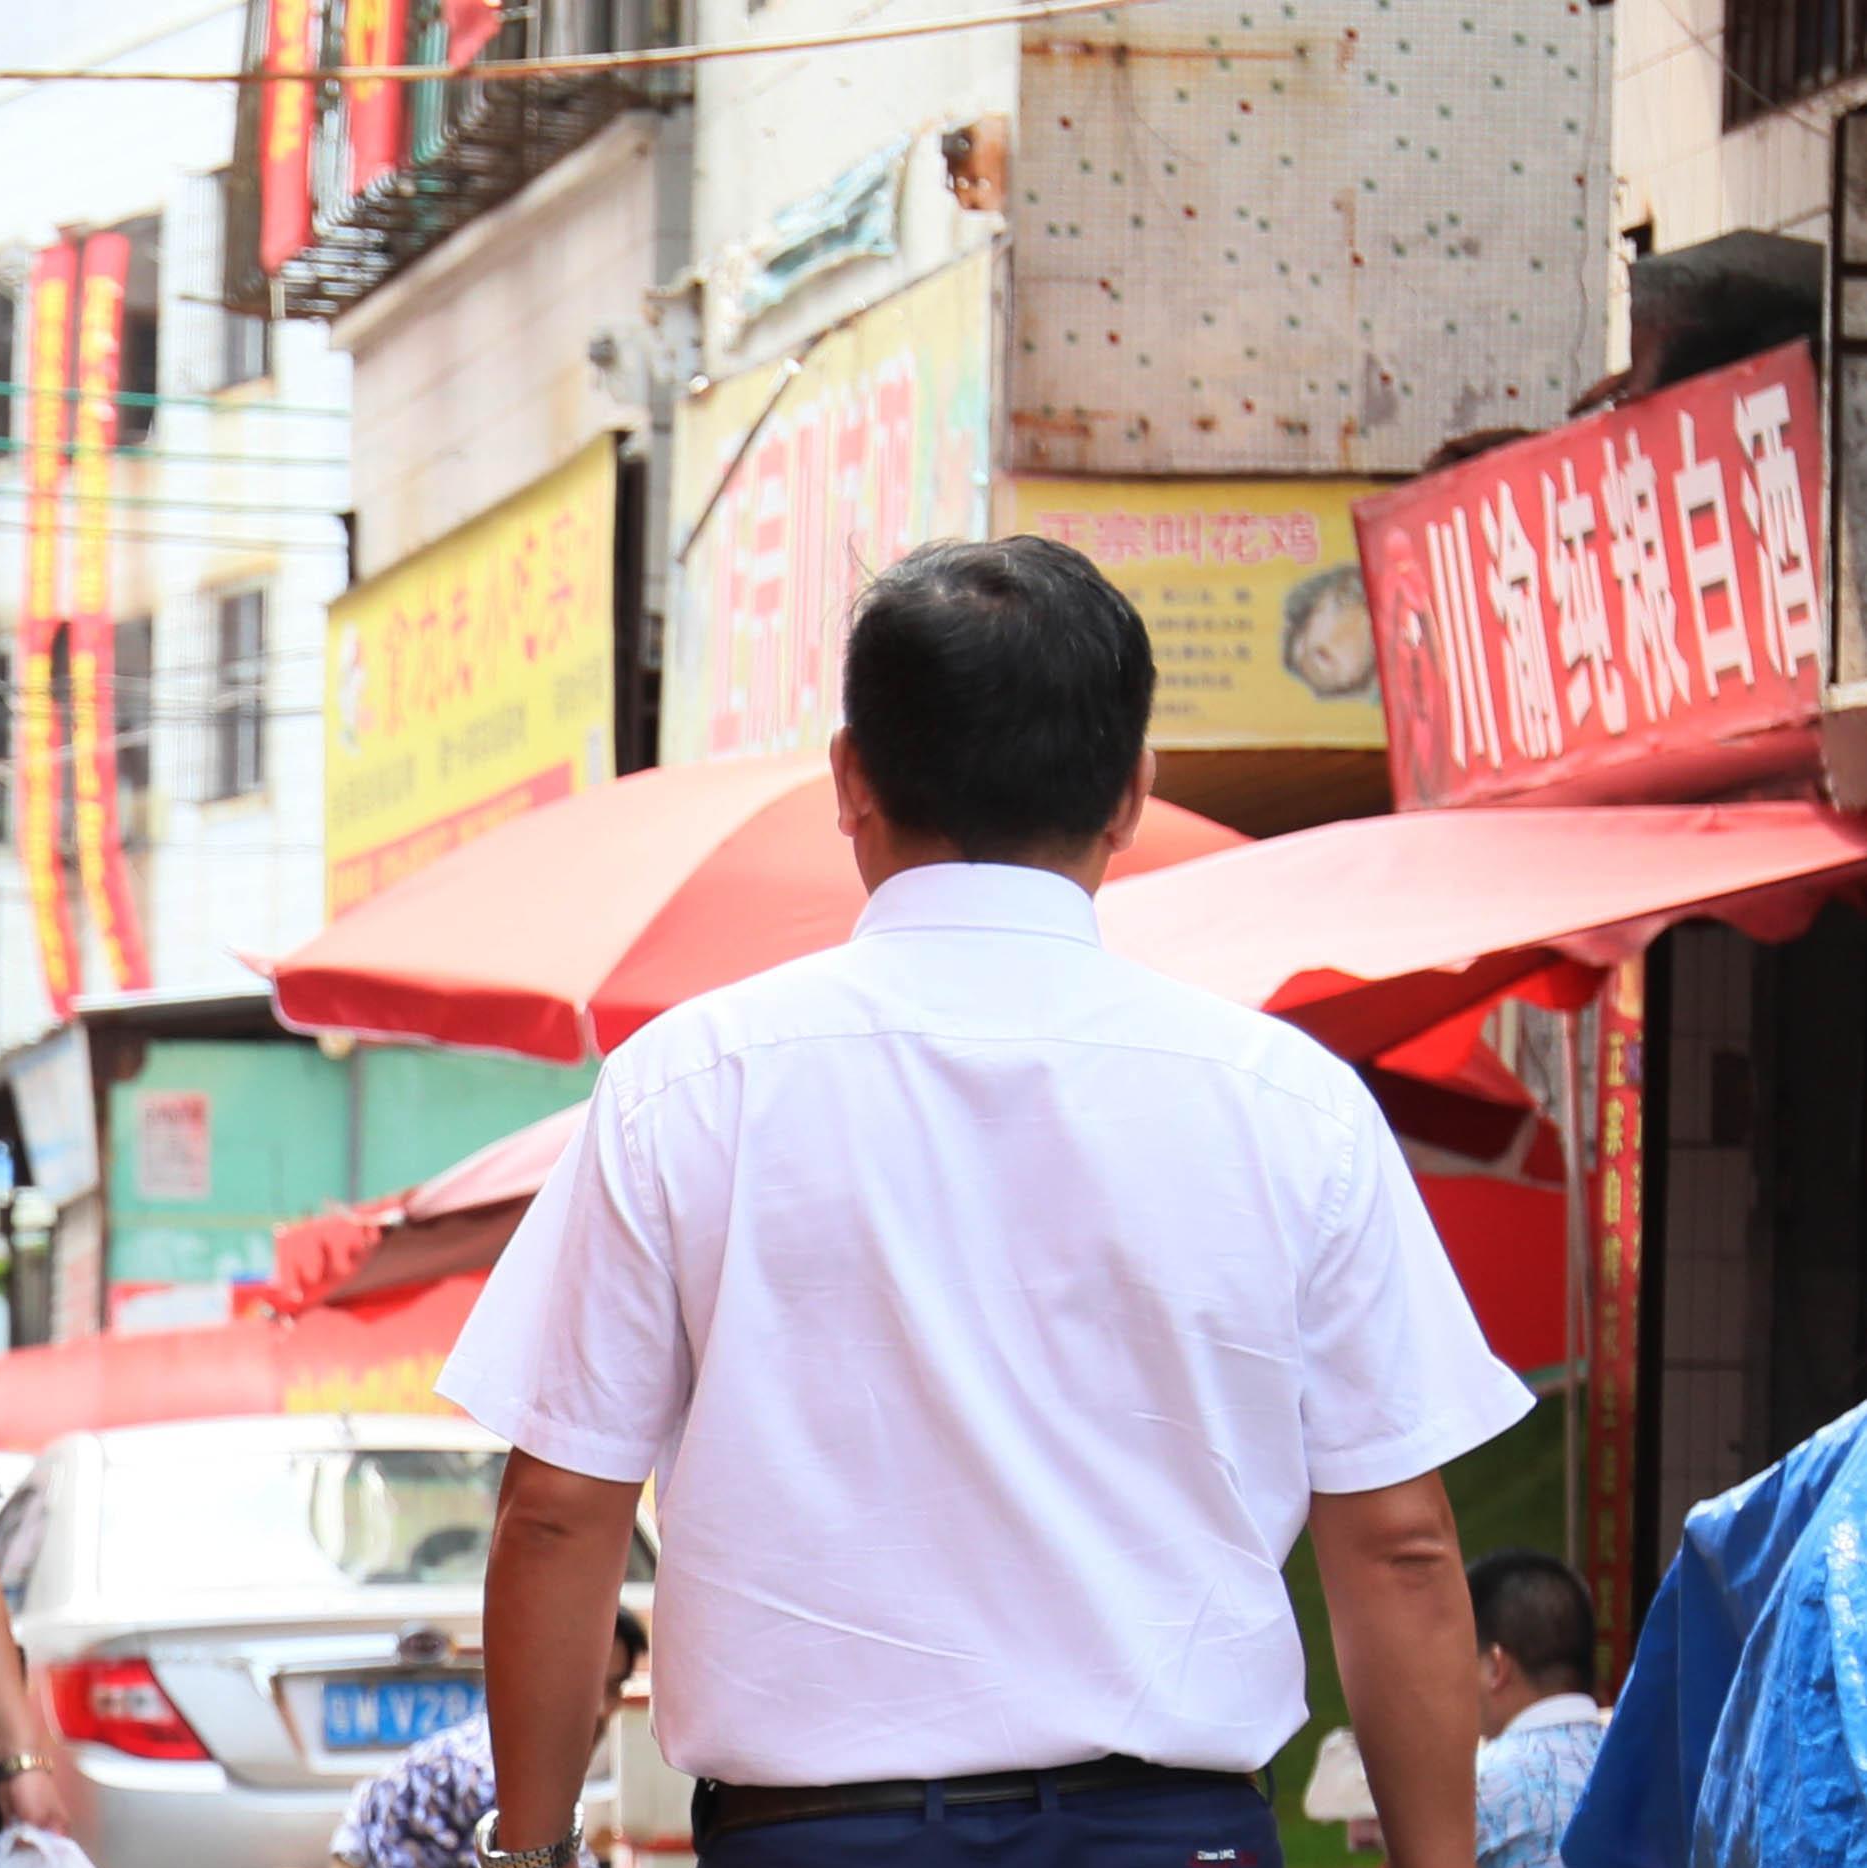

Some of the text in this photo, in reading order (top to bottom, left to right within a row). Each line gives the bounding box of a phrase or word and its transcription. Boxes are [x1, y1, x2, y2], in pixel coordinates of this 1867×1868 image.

[1425, 382, 1821, 770] 川渝纯粮白酒
